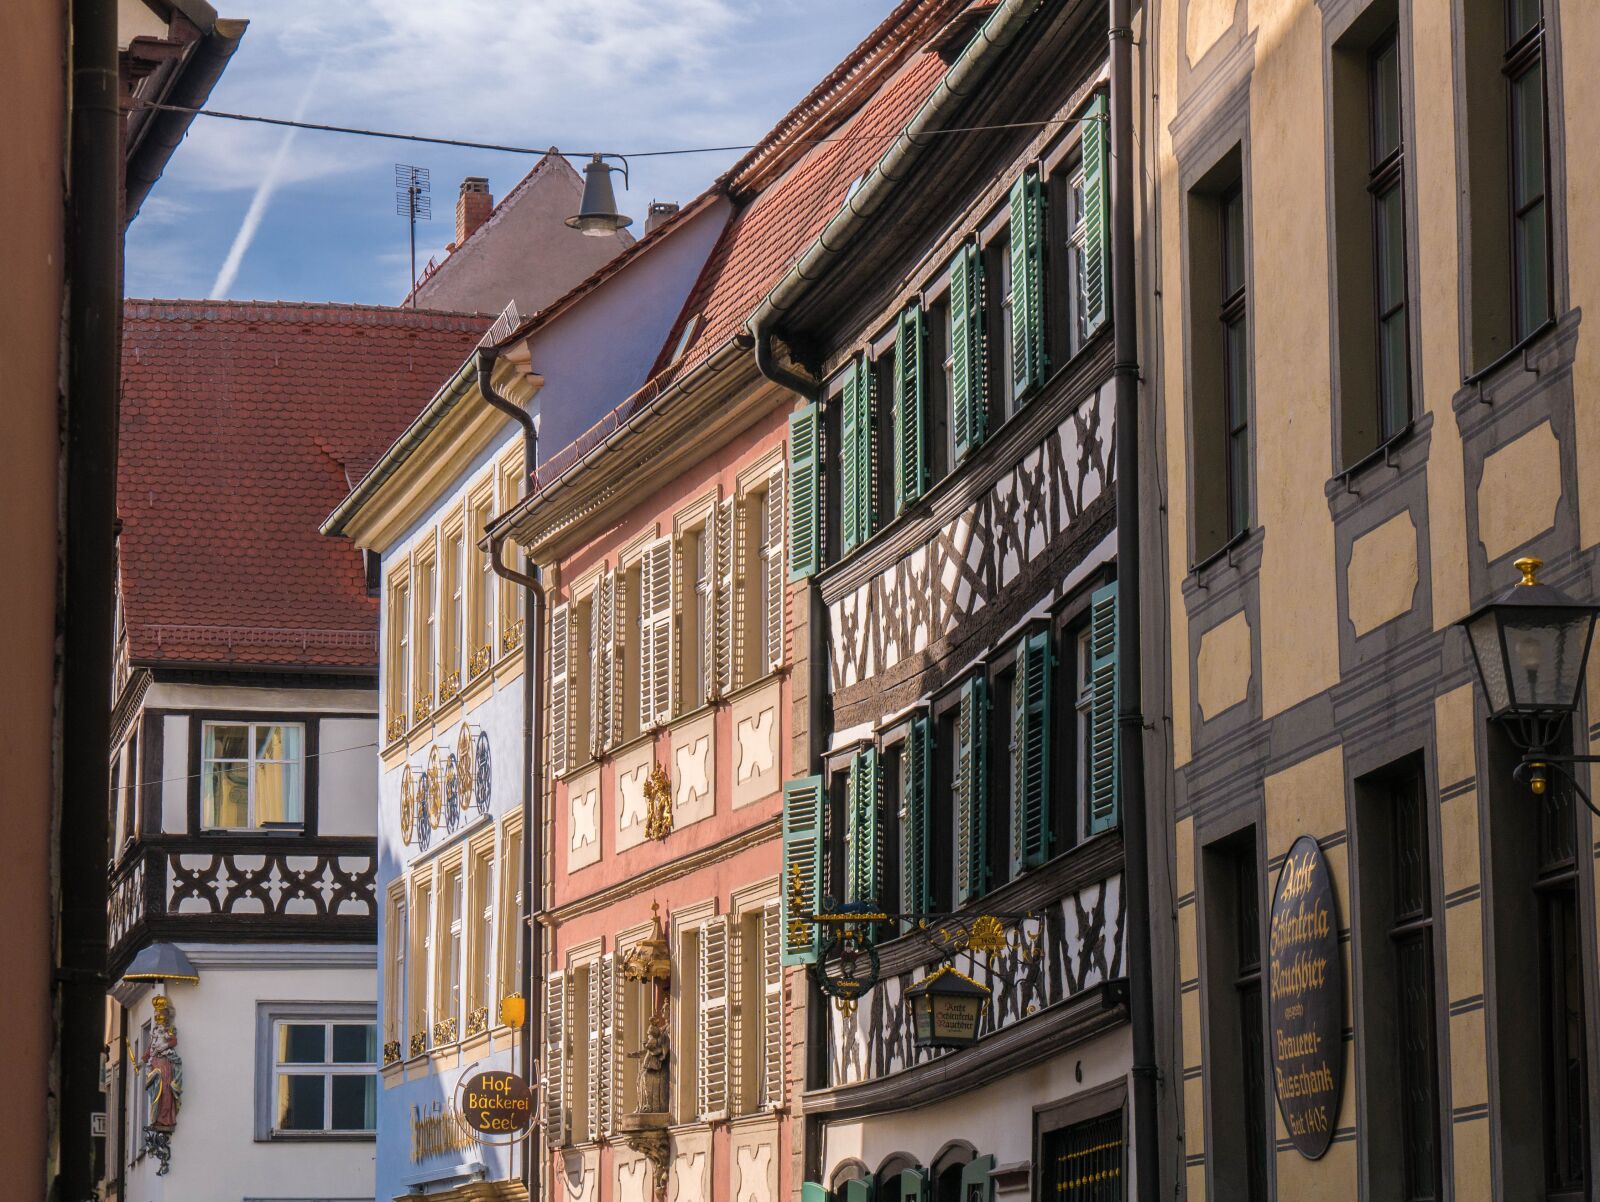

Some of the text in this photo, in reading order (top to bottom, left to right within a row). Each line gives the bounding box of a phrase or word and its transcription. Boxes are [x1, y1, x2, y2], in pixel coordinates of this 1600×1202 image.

[1271, 948, 1327, 1002] Rauchbier
[1276, 1021, 1322, 1060] Brauerei-
[1075, 1060, 1083, 1083] 6
[1276, 1061, 1333, 1100] Ausschank
[482, 1075, 513, 1095] Hof
[469, 1093, 529, 1110] Bäckerei
[480, 1111, 518, 1129] Seel
[1305, 1105, 1328, 1133] 1405
